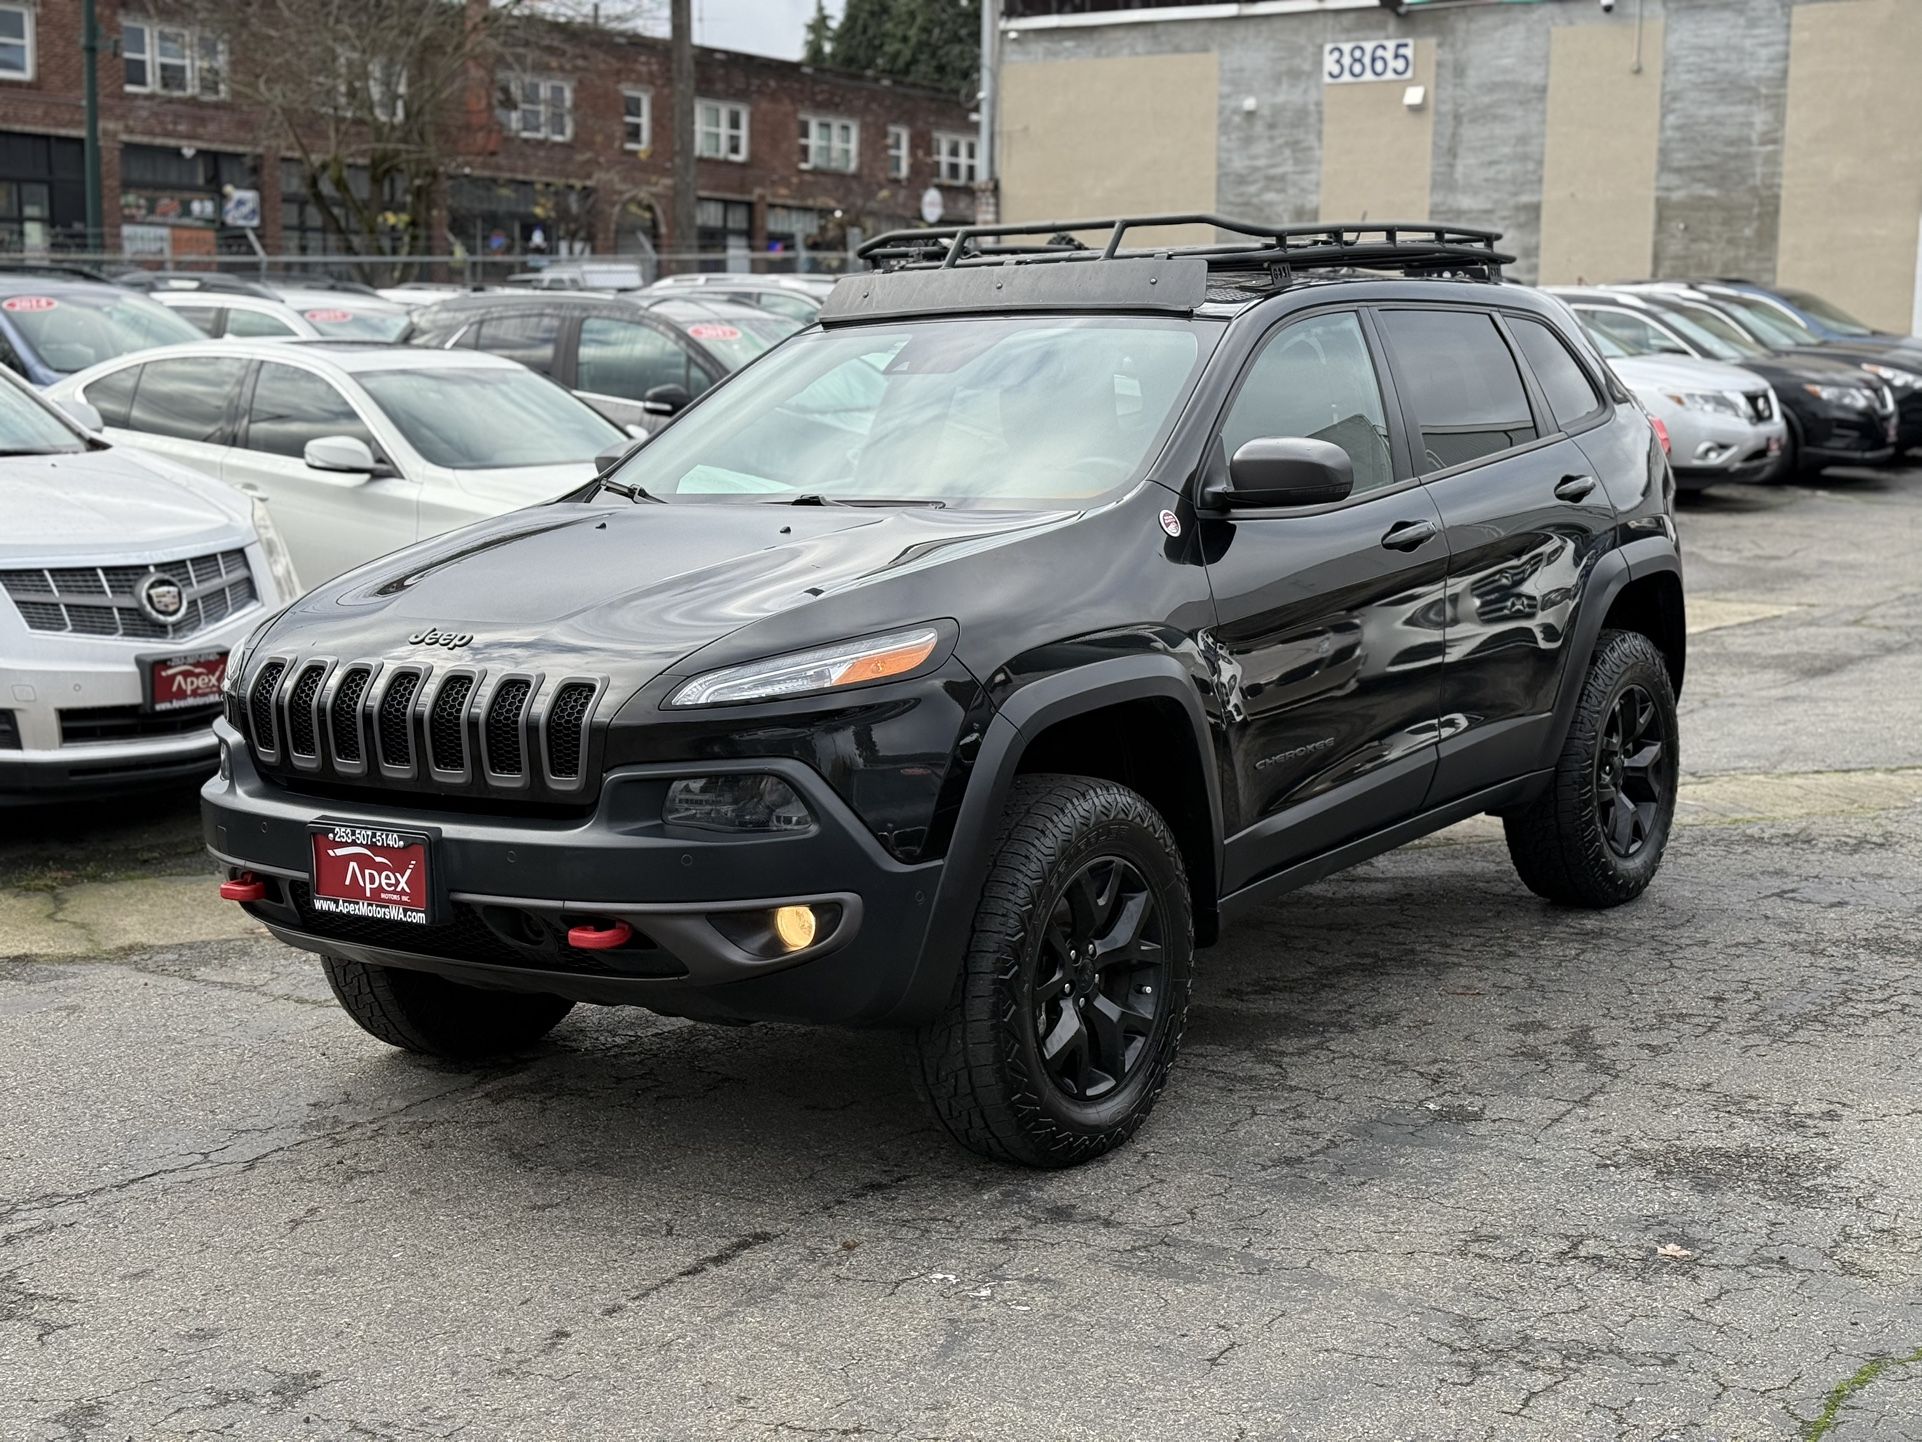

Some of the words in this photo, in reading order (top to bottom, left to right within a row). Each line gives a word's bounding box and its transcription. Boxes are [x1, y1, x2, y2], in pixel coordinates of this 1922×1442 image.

[1327, 43, 1409, 79] 3865
[408, 626, 475, 650] Jeep
[171, 664, 225, 695] Apex
[1255, 737, 1335, 770] CHEROKEE
[334, 827, 399, 848] 253-507-5140
[344, 860, 417, 897] Apex
[380, 892, 400, 901] MOTORS
[313, 899, 426, 924] www.ApexMotorsWA.com
